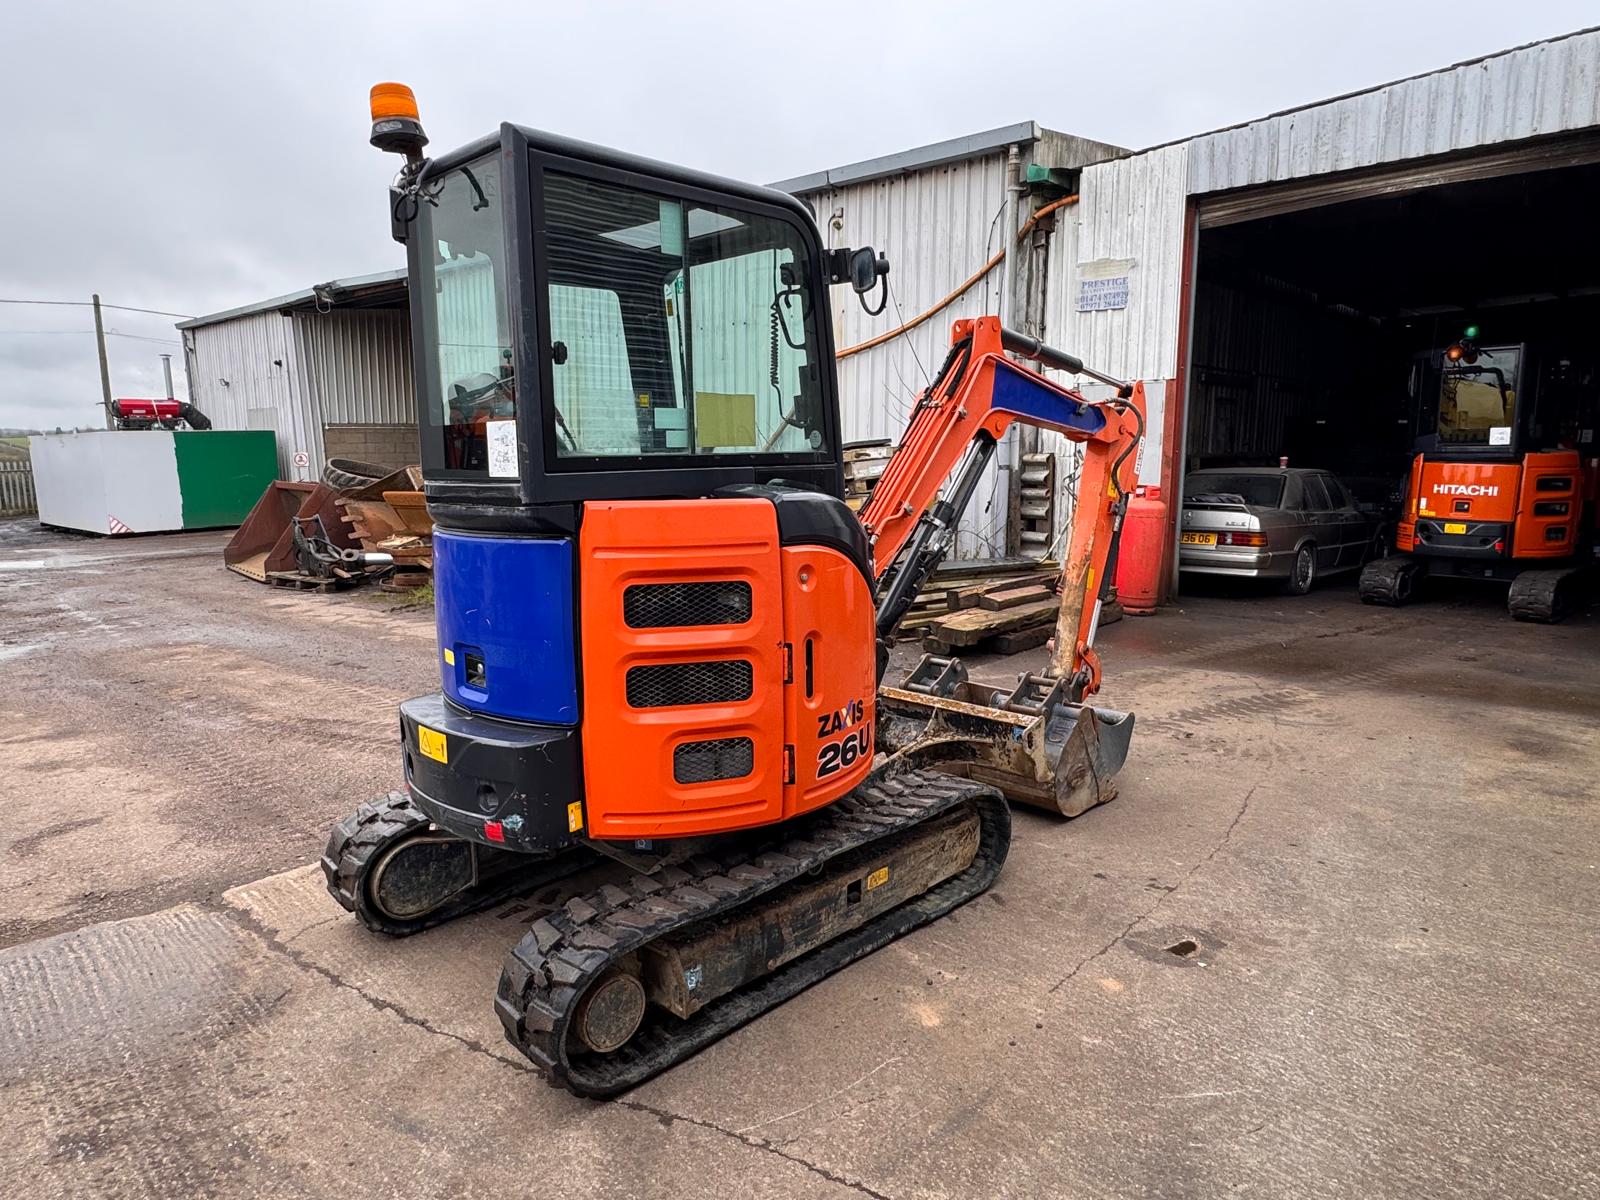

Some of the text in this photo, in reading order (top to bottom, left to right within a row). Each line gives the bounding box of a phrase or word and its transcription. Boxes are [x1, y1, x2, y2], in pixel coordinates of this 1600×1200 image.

[1081, 276, 1129, 289] PRESTIGE
[1433, 483, 1499, 497] HITACHI
[1198, 534, 1211, 543] 06
[817, 697, 864, 739] ZAXIS
[816, 721, 871, 780] 26U
